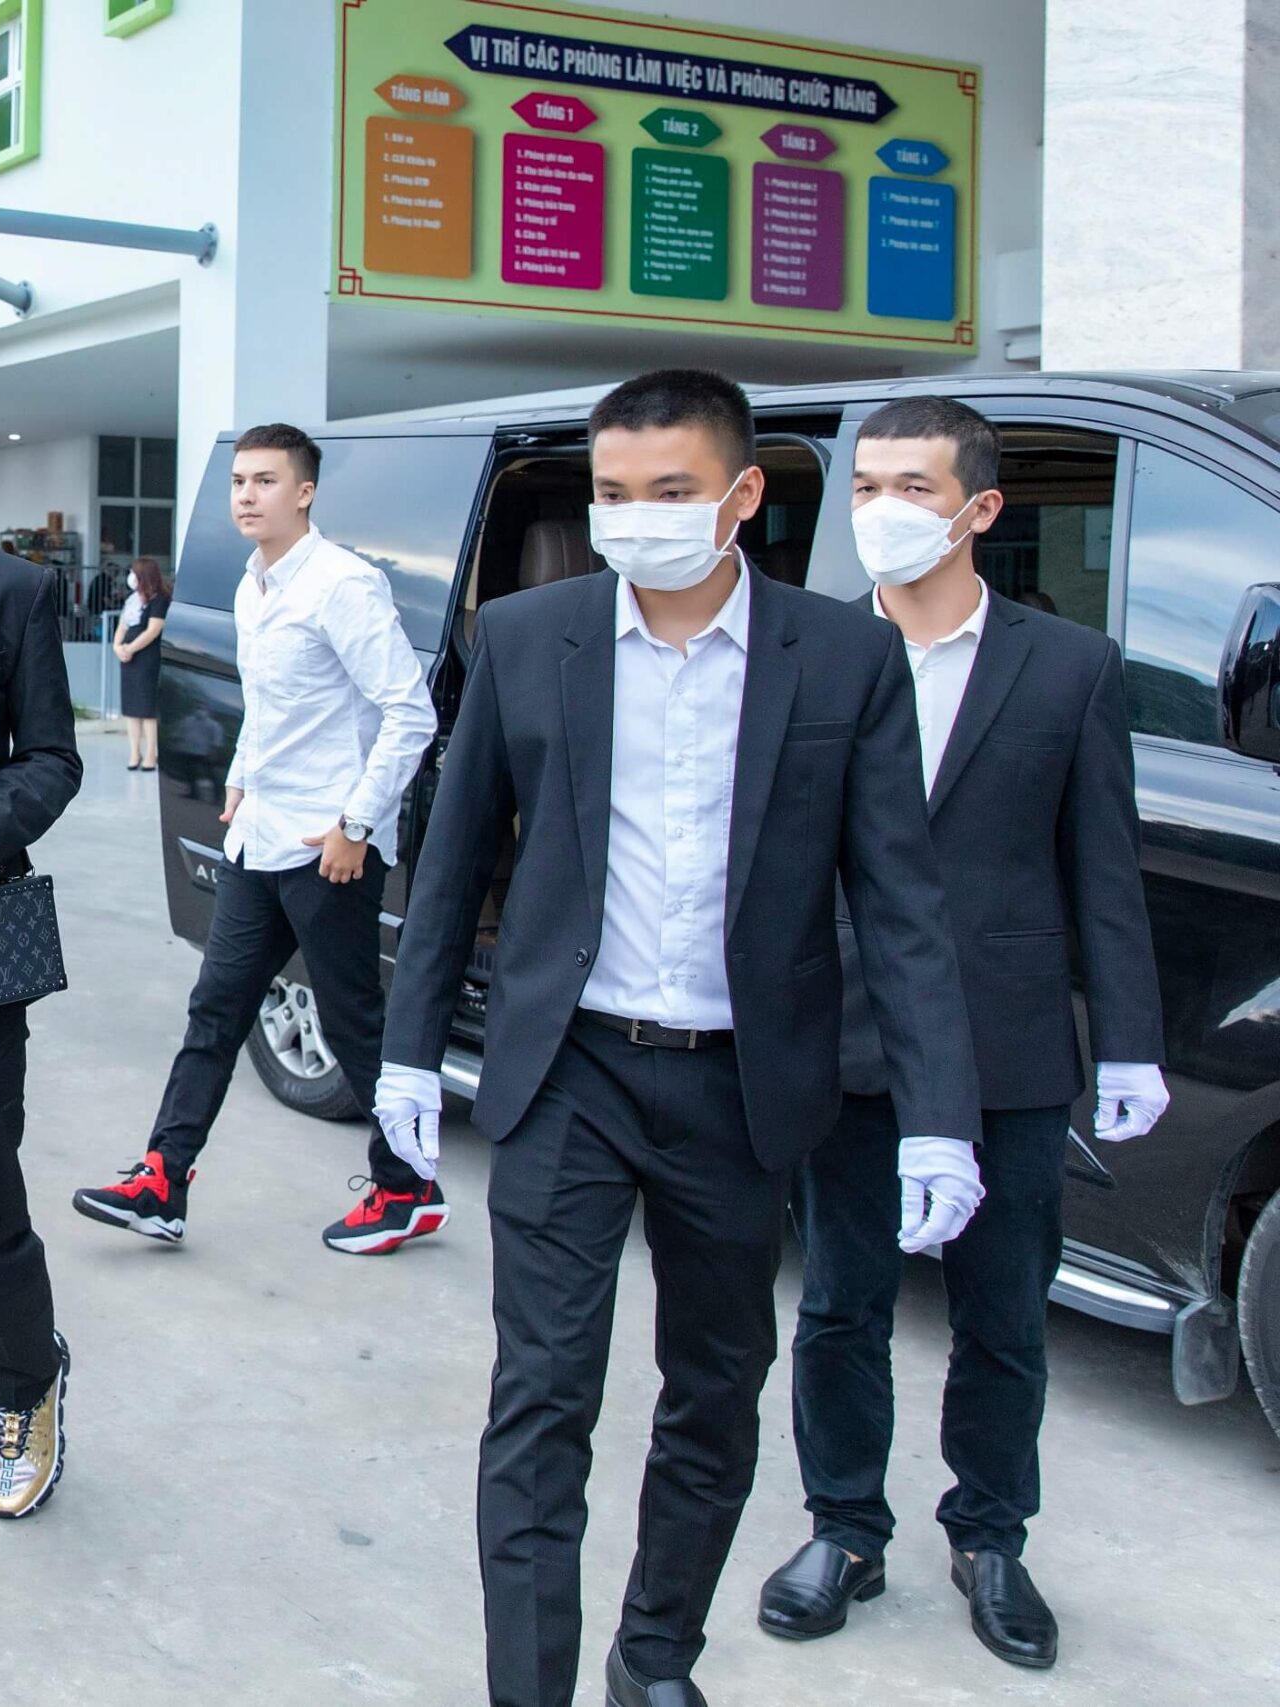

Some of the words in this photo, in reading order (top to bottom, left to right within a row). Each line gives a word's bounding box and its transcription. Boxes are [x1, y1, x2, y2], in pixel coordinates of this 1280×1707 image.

[470, 35, 487, 67] VỊ
[492, 36, 520, 66] TRÍ
[524, 39, 559, 71] CÁC
[564, 46, 621, 79] PHÒNG
[626, 53, 662, 84] LÀM
[665, 60, 702, 94] VIỆC
[706, 64, 728, 94] VÀ
[731, 68, 785, 101] PHÒNG
[789, 78, 830, 108] CHỨC
[834, 84, 877, 114] NĂNG
[692, 124, 699, 136] 2
